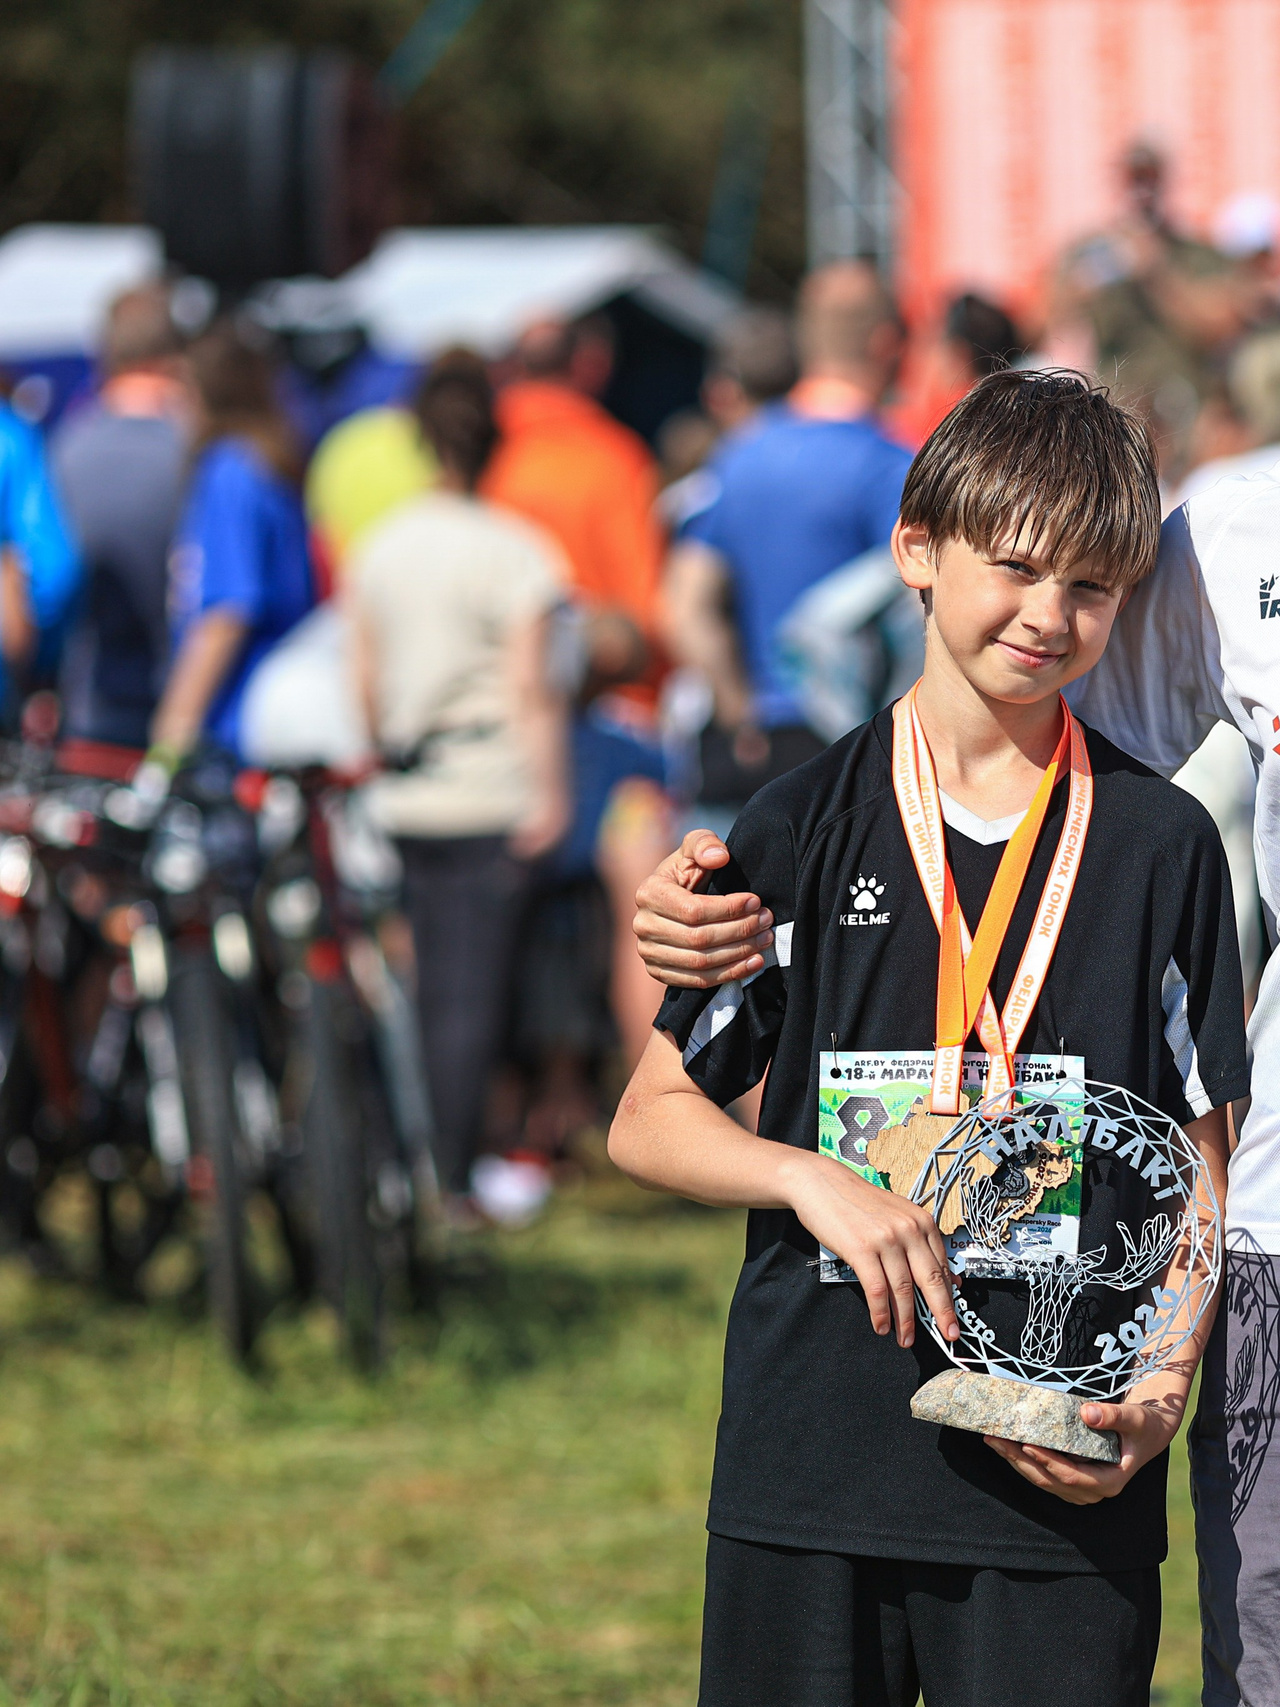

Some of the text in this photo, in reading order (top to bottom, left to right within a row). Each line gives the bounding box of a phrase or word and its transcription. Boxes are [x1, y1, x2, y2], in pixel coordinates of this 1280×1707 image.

[839, 912, 891, 926] KELME
[1038, 883, 1065, 938] ГОНОК
[1006, 974, 1034, 1044] ФЕДЕРА
[845, 1068, 875, 1080] 18-й
[939, 1048, 955, 1095] ОНОК
[1036, 1153, 1047, 1179] 2026
[1093, 1284, 1180, 1363] 2026
